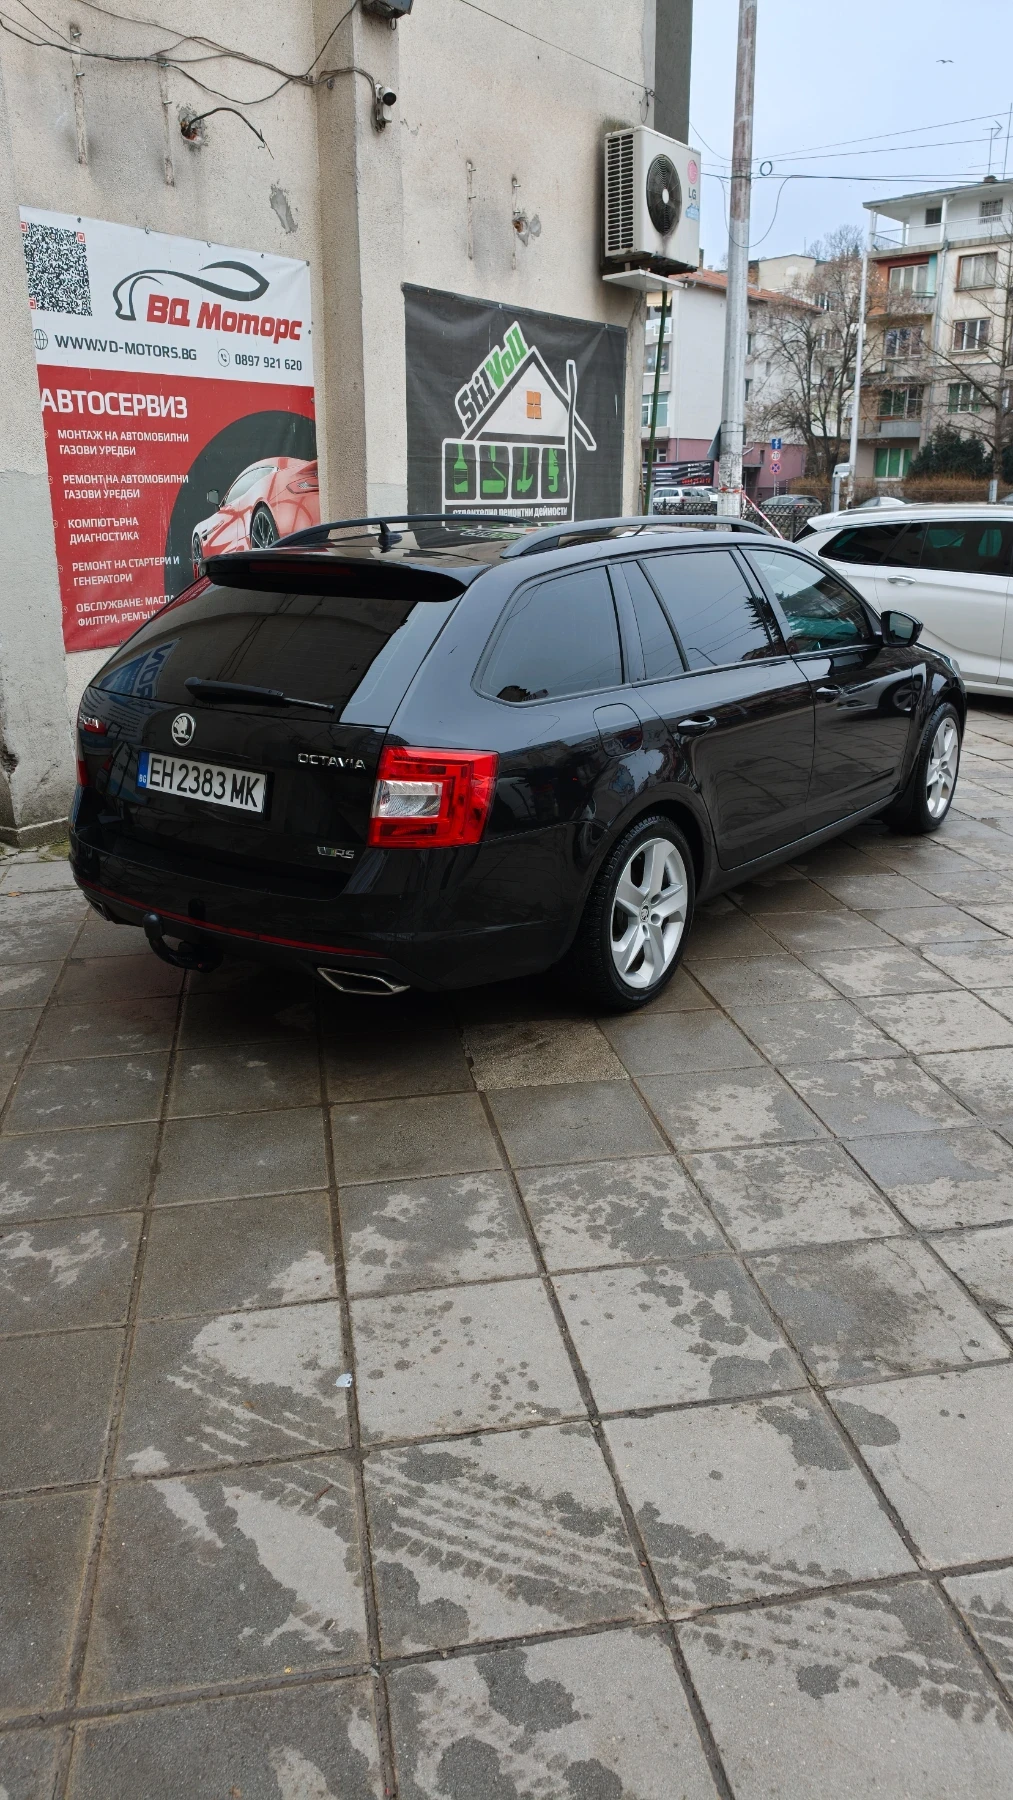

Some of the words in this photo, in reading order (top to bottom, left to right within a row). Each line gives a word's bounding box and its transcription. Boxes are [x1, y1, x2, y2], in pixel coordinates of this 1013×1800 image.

[688, 187, 697, 200] LG
[196, 302, 303, 345] Моторс
[54, 334, 198, 362] WWW.VD-MOTORS.BG
[234, 352, 260, 367] 0897
[263, 354, 281, 369] 921
[284, 357, 303, 372] 620
[40, 388, 188, 419] АВТОСЕРВИЗ
[57, 429, 103, 441] МОНТАЖ
[105, 431, 119, 441] НА
[120, 432, 189, 443] АВТОМОБИЛНИ
[59, 445, 98, 456] ГАЗОВИ
[99, 446, 136, 457] УРЕДБИ
[62, 474, 104, 485] РЕМОНТ
[105, 474, 119, 484] НА
[120, 474, 189, 484] АВТОМОБИЛНИ
[64, 489, 102, 500] ГАЗОВИ
[103, 489, 140, 500] УРЕДБИ
[67, 517, 139, 529] КОМПЮТЪРНА
[69, 531, 139, 545] ДИАГНОСТИКА
[72, 560, 113, 572] РЕМОНТ
[114, 559, 127, 570] НА
[128, 556, 172, 569] СТАРТЕРИ
[173, 555, 180, 565] И
[73, 574, 133, 587] ГЕНЕРАТОРИ
[76, 597, 144, 613] ОБСЛУЖВАНЕ:
[78, 613, 120, 627] ФИЛТРИ,
[297, 752, 367, 770] OCTAVIA
